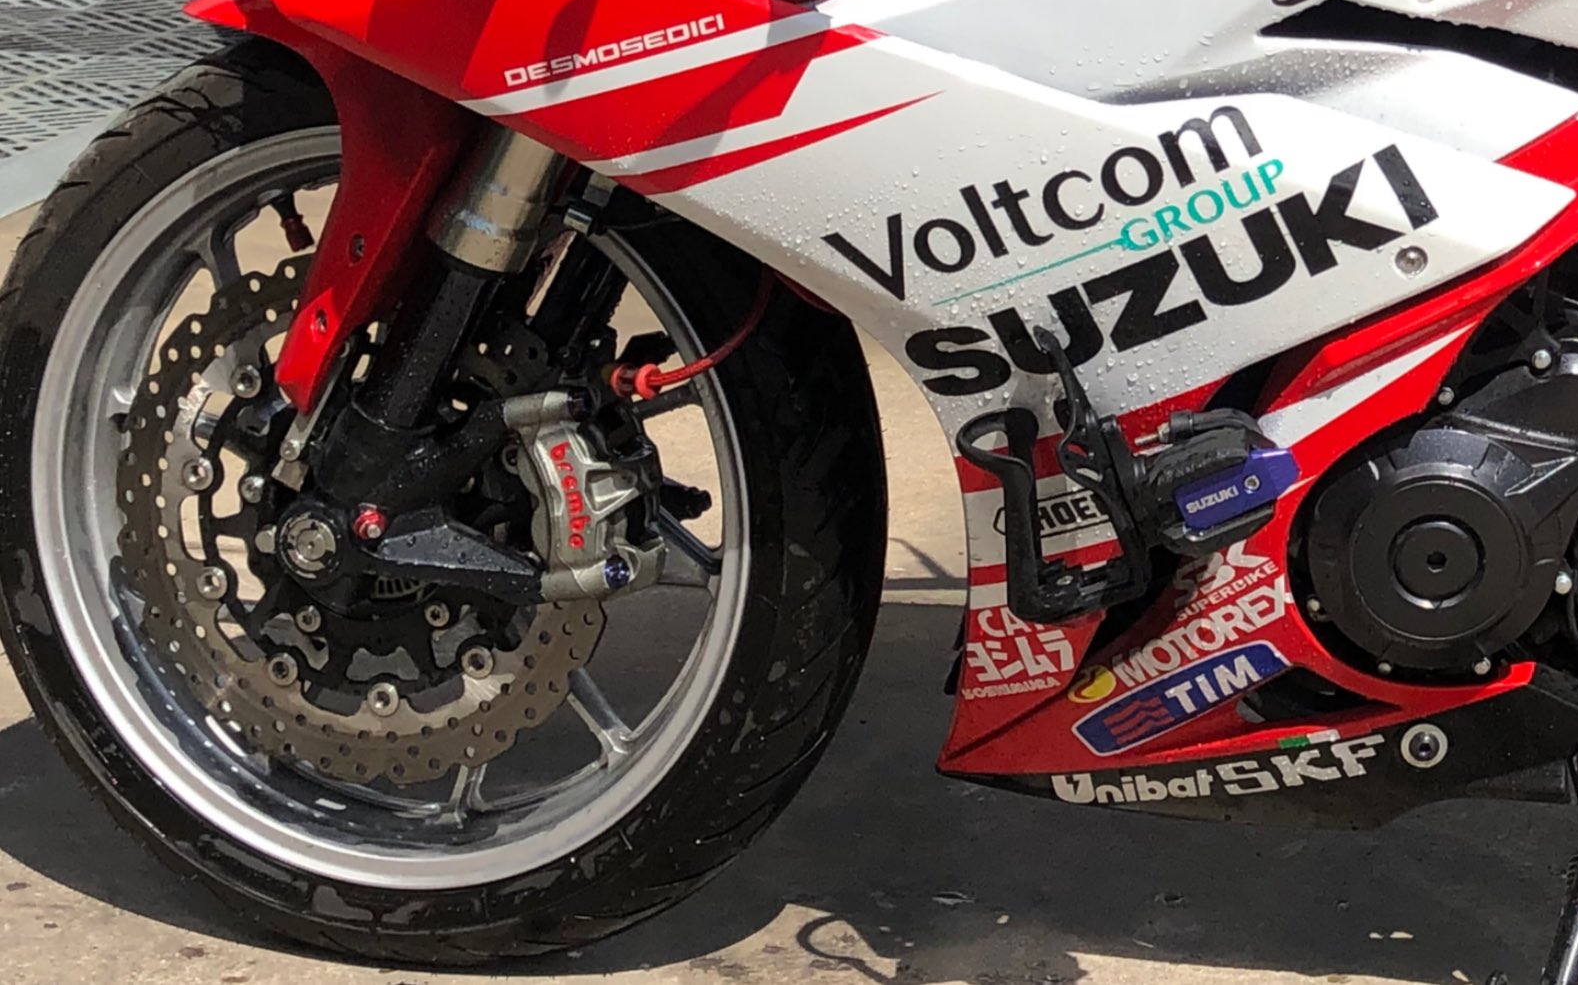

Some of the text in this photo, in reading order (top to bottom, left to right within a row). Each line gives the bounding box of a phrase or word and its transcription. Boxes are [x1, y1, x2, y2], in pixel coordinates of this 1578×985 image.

[504, 13, 725, 87] DESMOSEDICI
[821, 105, 1265, 302] Voltcom
[1118, 159, 1286, 252] GROUP
[905, 143, 1440, 397] SUZUKI
[551, 441, 591, 550] brembo
[1186, 484, 1239, 514] SUZUKI
[1177, 560, 1280, 622] SUPERBIKE
[1112, 574, 1295, 688] MOTOREX
[962, 676, 1061, 700] YOSHIMURA
[1164, 654, 1263, 715] TIM
[1051, 768, 1214, 804] Unibat
[1215, 734, 1386, 796] SKF
